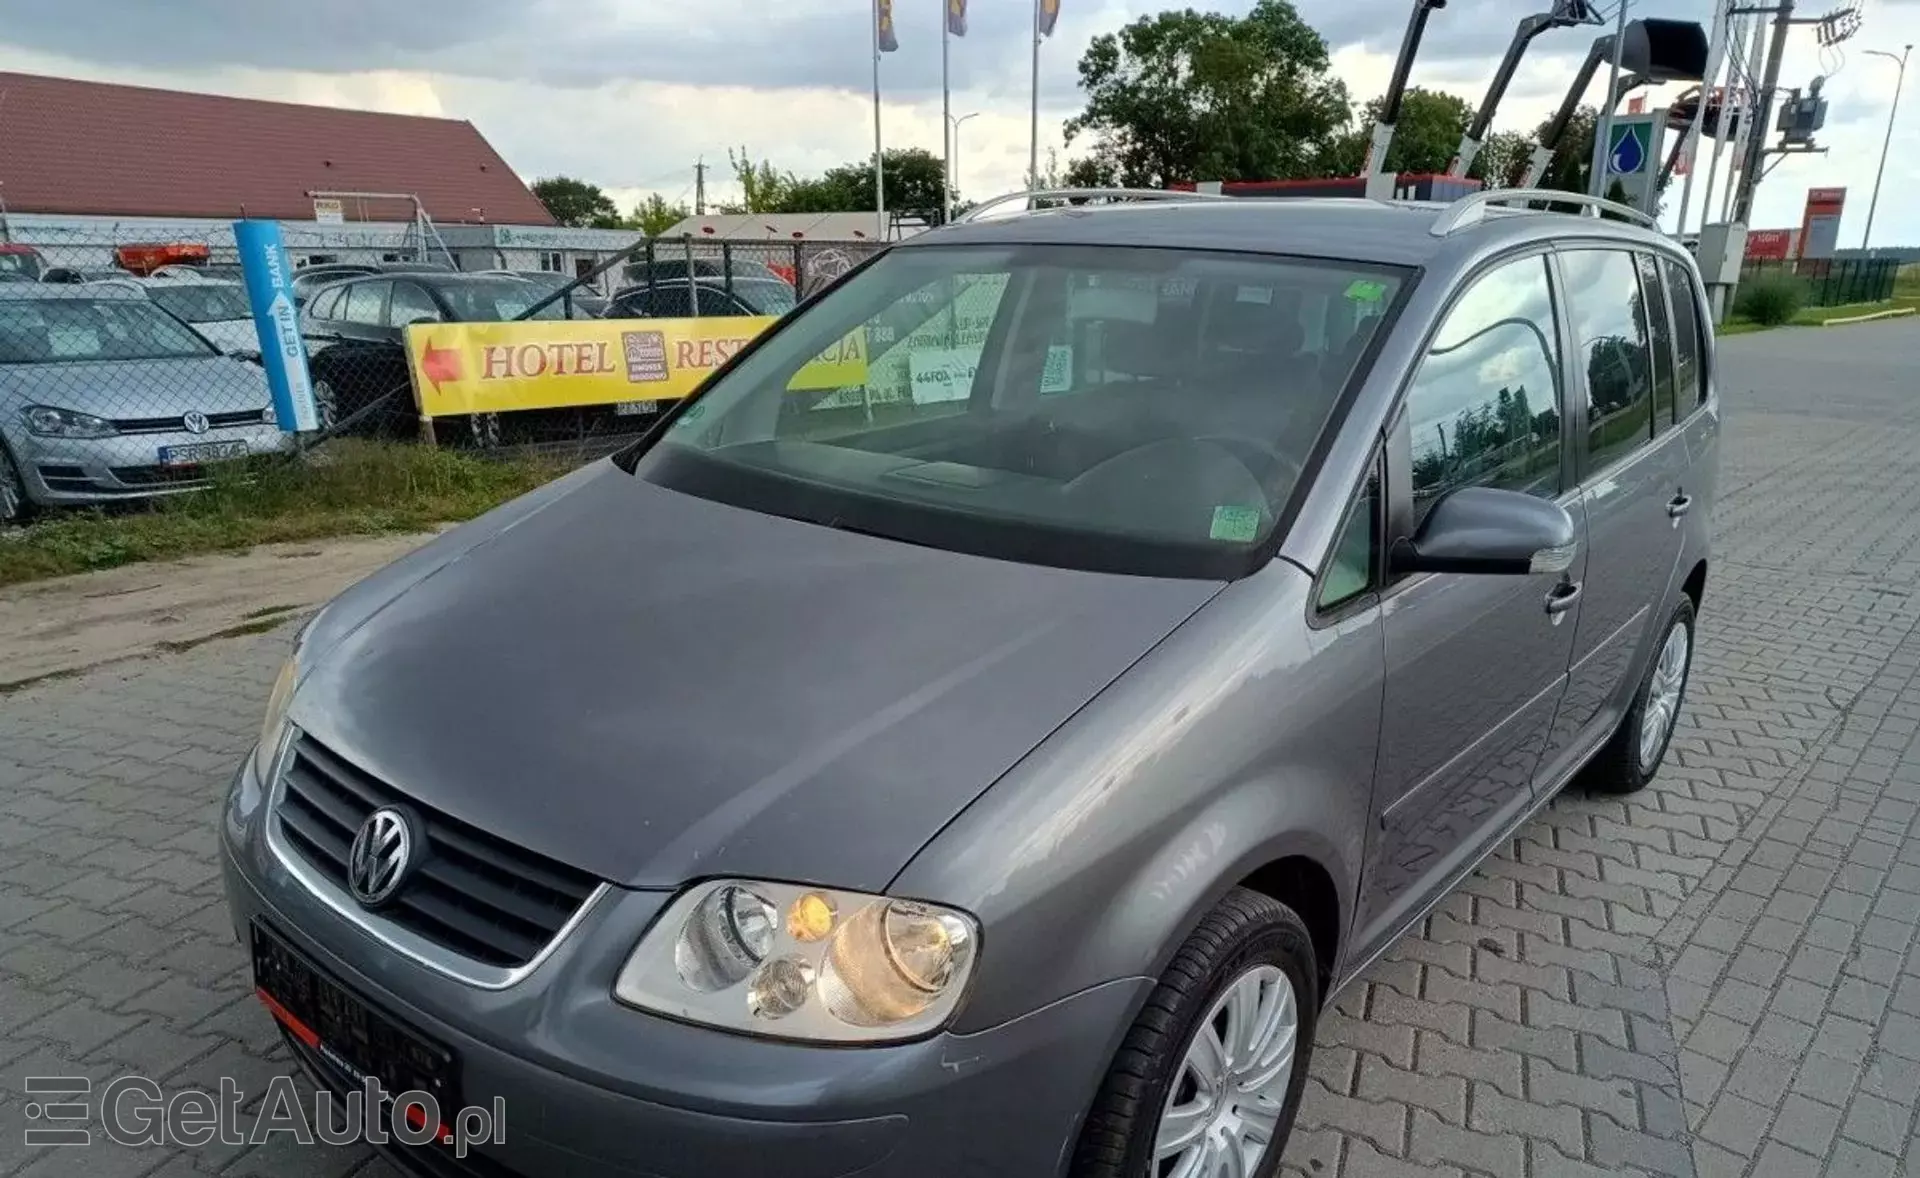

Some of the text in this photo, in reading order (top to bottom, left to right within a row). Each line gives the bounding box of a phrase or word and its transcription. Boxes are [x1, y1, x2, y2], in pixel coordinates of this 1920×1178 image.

[264, 243, 299, 358] GET IN BANK
[481, 340, 616, 380] HOTEL
